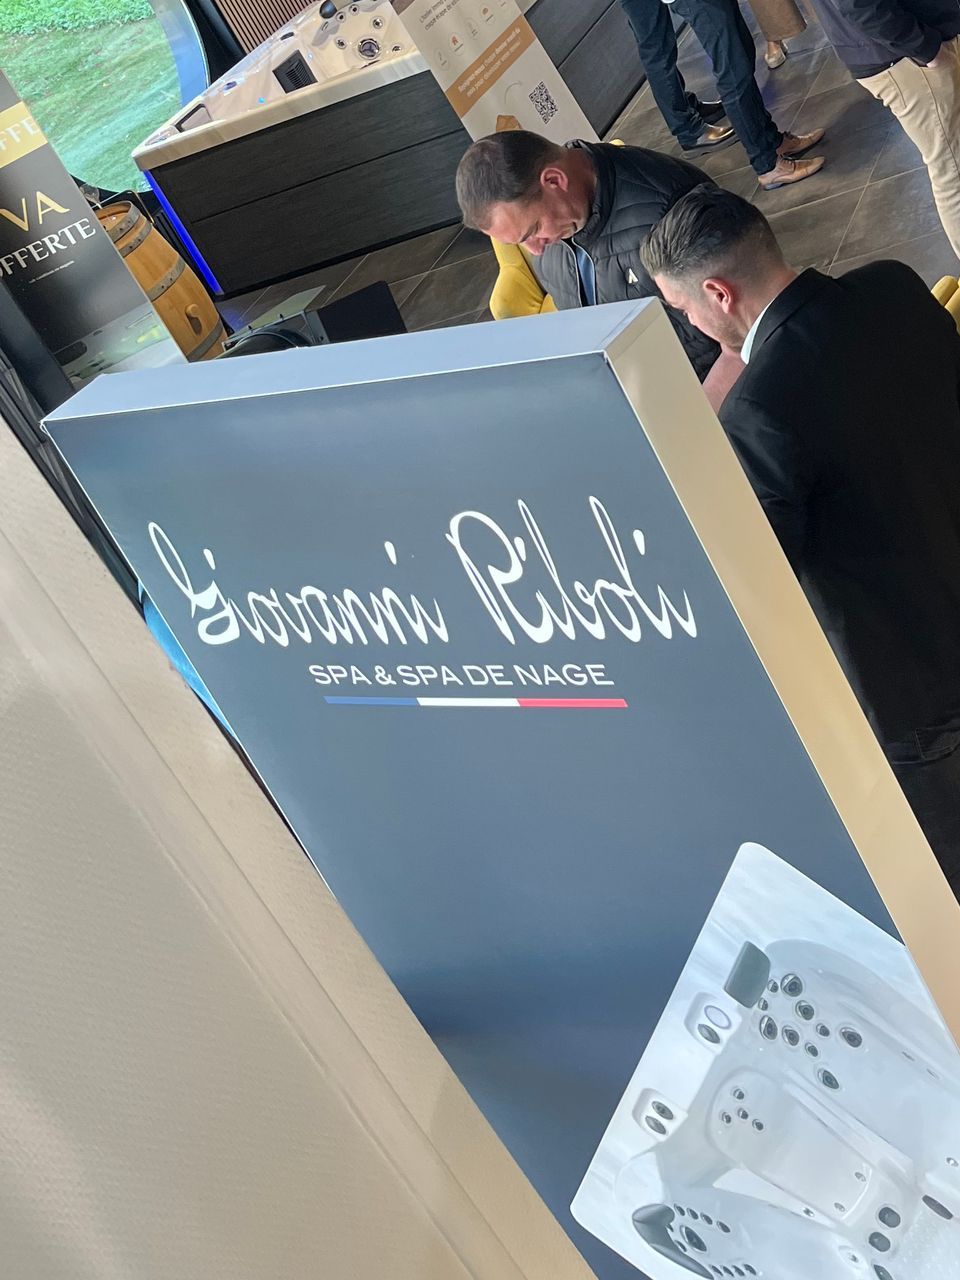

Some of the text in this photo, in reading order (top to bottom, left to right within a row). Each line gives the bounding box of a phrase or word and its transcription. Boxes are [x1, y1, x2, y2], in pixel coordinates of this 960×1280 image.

[0, 218, 97, 277] FFERTE
[148, 496, 698, 647] Giovanni Riboli
[309, 664, 615, 686] SPA & SPA DE NAGE
